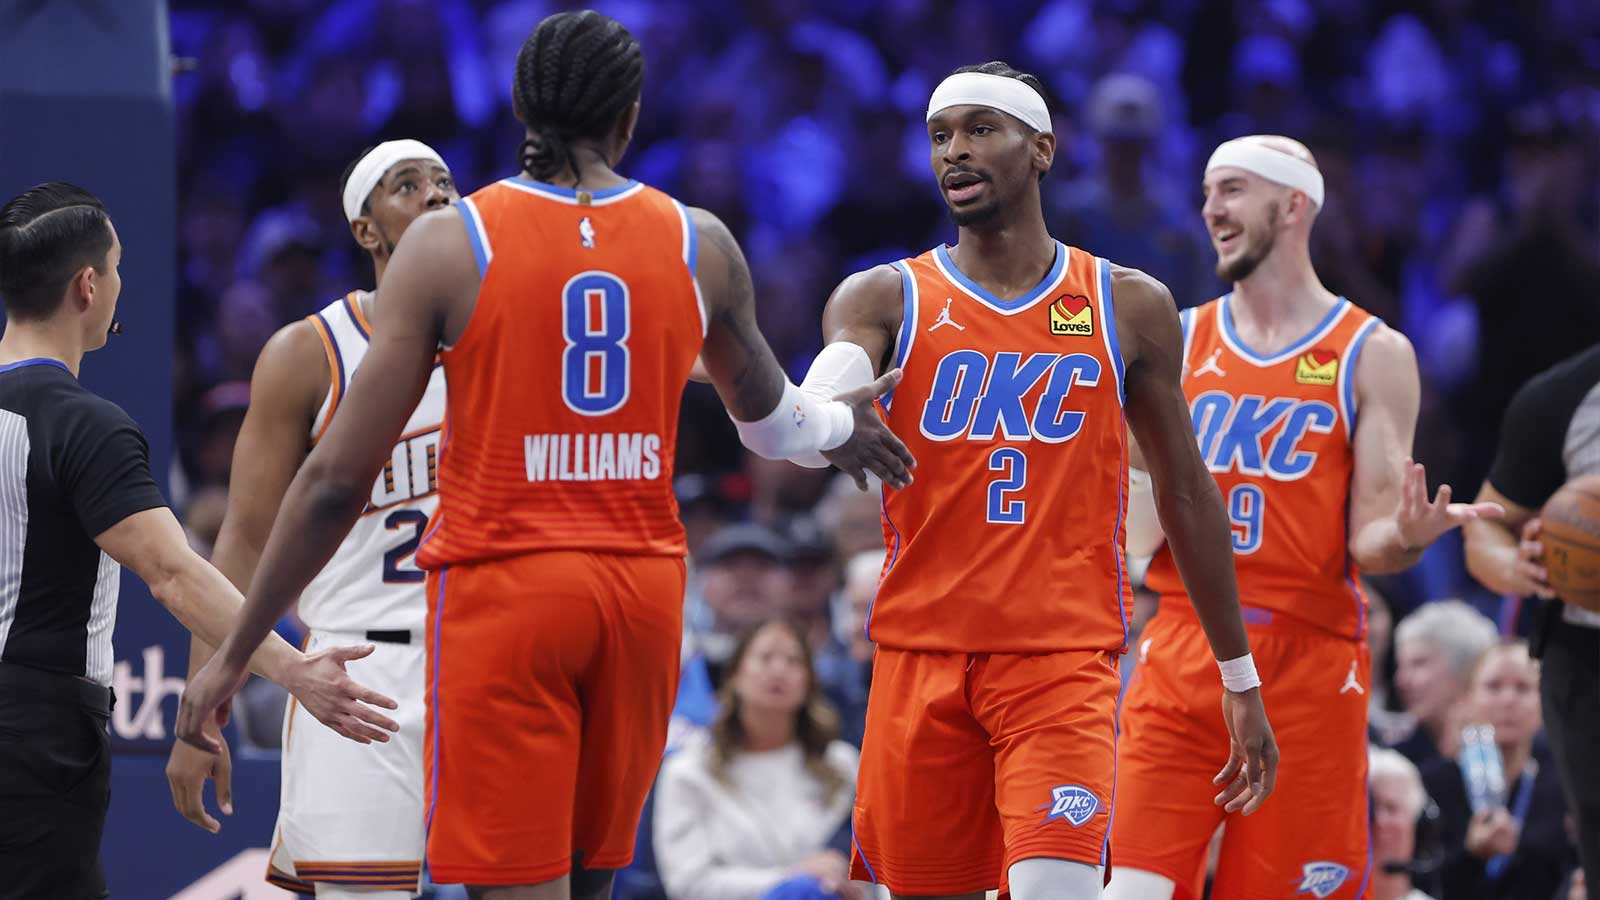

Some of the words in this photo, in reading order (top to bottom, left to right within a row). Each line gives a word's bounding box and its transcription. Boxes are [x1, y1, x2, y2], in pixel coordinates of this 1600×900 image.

[562, 270, 631, 417] 8
[919, 349, 1102, 444] OKC
[524, 432, 660, 482] WILLIAMS
[1191, 389, 1338, 482] OKC
[986, 447, 1027, 524] 2
[1229, 483, 1265, 555] 9
[1050, 796, 1092, 815] OKC
